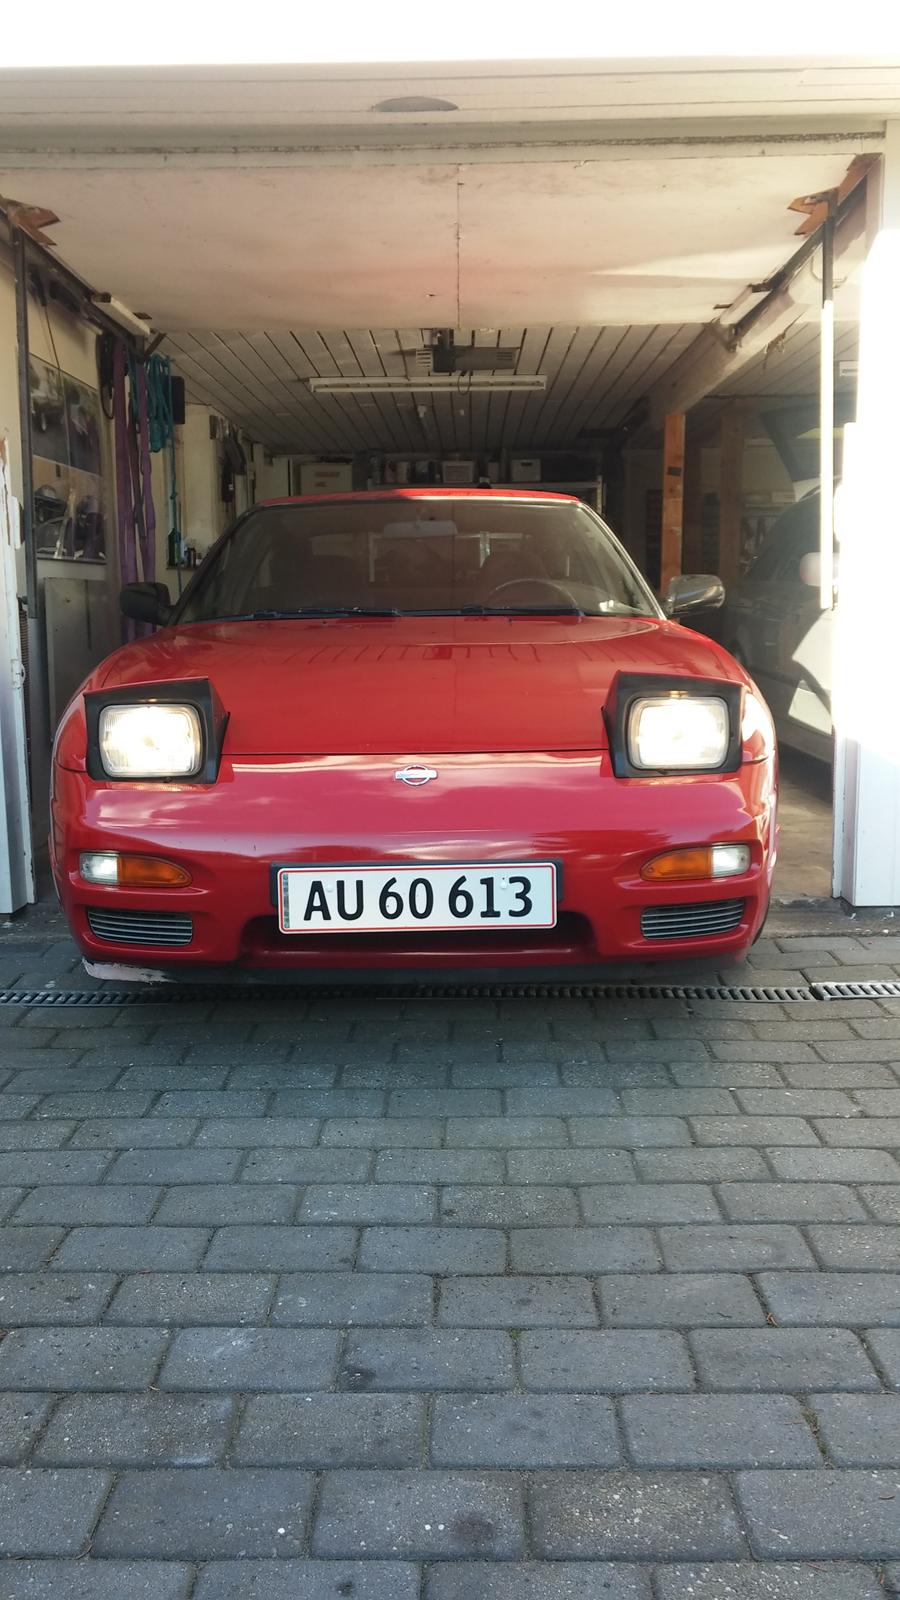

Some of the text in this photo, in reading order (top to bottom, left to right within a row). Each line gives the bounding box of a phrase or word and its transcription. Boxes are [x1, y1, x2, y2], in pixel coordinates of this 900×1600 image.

[303, 875, 533, 921] AU 60 613
